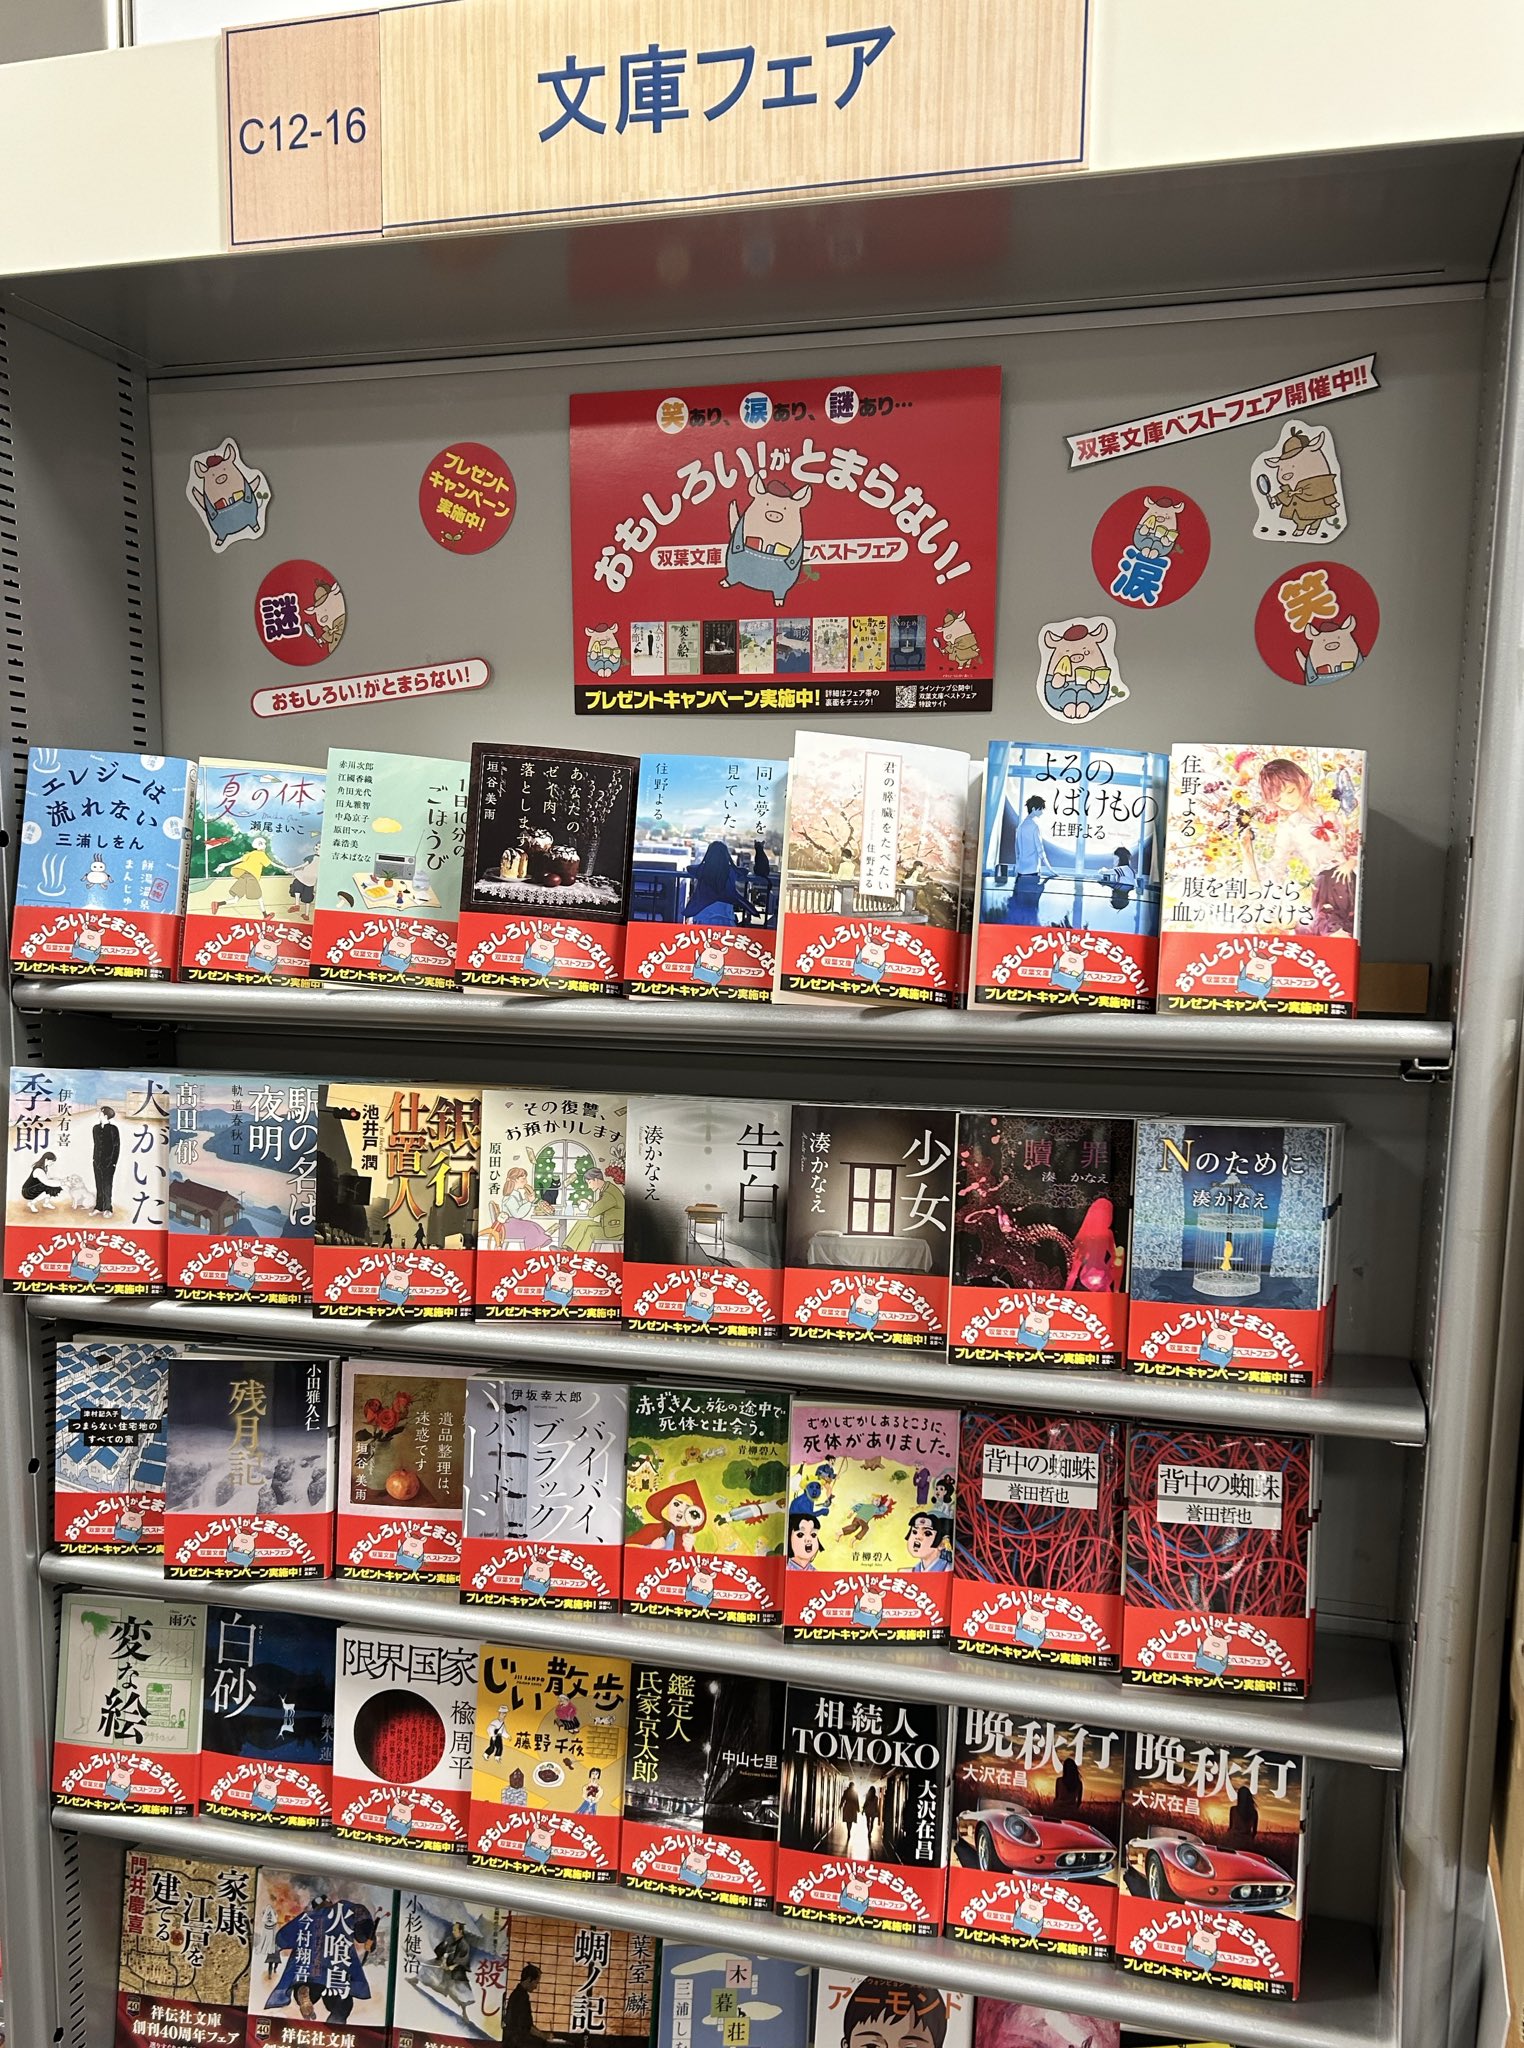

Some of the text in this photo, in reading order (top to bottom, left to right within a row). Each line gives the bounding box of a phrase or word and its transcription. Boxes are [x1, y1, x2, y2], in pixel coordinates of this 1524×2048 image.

[538, 25, 897, 141] 文庫フェア
[239, 106, 366, 156] C12-16
[1077, 366, 1367, 461] 双葉文庫ベストフェア開催中!!
[429, 471, 510, 517] キャンペーン
[444, 452, 509, 493] プレゼント
[435, 498, 486, 531] 実施中!
[594, 439, 971, 592] おもしろい!がとまらない!
[658, 548, 722, 567] 双葉文庫
[809, 541, 901, 560] ベストフェア
[1114, 548, 1167, 605] 涙
[262, 594, 301, 641] 謎
[1281, 571, 1338, 630] 笑
[272, 667, 470, 711] おもしろい!がとまらない!
[585, 689, 820, 709] プレゼントキャンペーン実施中!
[825, 689, 879, 698] 詳細はフェア帯の
[825, 698, 874, 707] 裏面をチェック!
[919, 692, 977, 700] 双葉文庫ベストフェア
[41, 762, 168, 804] エレジーは
[338, 773, 373, 784] 江國香織
[339, 760, 374, 771] 赤川次郎
[1034, 752, 1114, 784] よるの
[206, 773, 325, 822] 夏の体
[336, 800, 371, 810] 田丸雅智
[337, 787, 371, 797] 角田光代
[484, 760, 499, 821] 垣谷美雨
[517, 762, 535, 847] 落とします
[567, 767, 583, 833] あなたの
[653, 763, 669, 821] 住野よる
[723, 764, 740, 829] 見ていた
[755, 765, 773, 835] 同じ夢を
[1053, 788, 1158, 823] ばけもの
[1181, 755, 1202, 837] 住野よる
[45, 797, 158, 828] 流れない
[250, 820, 305, 835] 瀬尾まいこ
[333, 825, 366, 834] 原田マハ
[335, 813, 369, 823] 中島京子
[426, 785, 449, 871] ごほうび
[879, 760, 897, 891] 君の膵臓をたべたい
[1051, 821, 1107, 841] 住野よる
[56, 833, 145, 850] 三浦しをん
[332, 852, 371, 862] 吉本ばなな
[333, 839, 358, 849] 森浩美
[123, 859, 133, 913] まんじゅ
[865, 843, 876, 890] 住野よる
[1182, 877, 1301, 900] 腹を割ったら
[1170, 902, 1315, 926] 血が出るだけさ
[984, 987, 1135, 1009] プレゼントキャンペーン実施中!
[13, 1072, 54, 1154] 季節
[56, 1088, 73, 1147] 伊吹有喜
[248, 1086, 285, 1162] 夜明
[505, 1121, 624, 1142] お預かりします
[524, 1100, 606, 1121] その復讐、
[131, 1080, 169, 1225] 犬がいた
[286, 1087, 318, 1226] 駅の名は
[361, 1104, 379, 1170] 池井戸潤
[383, 1090, 429, 1221] 仕置人
[427, 1097, 482, 1208] 銀行
[1161, 1138, 1304, 1176] Nのために
[488, 1142, 502, 1195] 原田ひ香
[644, 1125, 664, 1201] 湊かなえ
[736, 1123, 784, 1223] 告白
[809, 1132, 831, 1213] 湊かなえ
[900, 1129, 951, 1232] 少女
[1192, 1190, 1269, 1210] 湊かなえ
[12, 1281, 149, 1295] プレゼントキャンペーン実施中!
[319, 1305, 458, 1318] プレゼントキャンペーン実施中!
[954, 1348, 1099, 1366] プレゼントキャンペーン実施中!
[305, 1364, 321, 1432] 小田雅久仁
[510, 1388, 582, 1403] 伊坂幸太郎
[636, 1391, 786, 1418] 赤ずきん、旅の途中で
[72, 1421, 158, 1432] つまらない住宅地の
[88, 1435, 134, 1444] すべての家
[228, 1380, 267, 1487] 残月記
[415, 1411, 430, 1472] 迷惑です
[658, 1417, 765, 1437] 死体と出会う。
[803, 1432, 951, 1458] 死体がありました。
[806, 1417, 946, 1436] むかしむかしあるところに、
[355, 1441, 369, 1501] 垣谷美雨
[437, 1413, 453, 1496] 遺品整理は、
[487, 1418, 515, 1503] バード
[738, 1445, 778, 1456] 青柳碧人
[984, 1447, 1096, 1481] 背中の蜘蛛
[530, 1418, 565, 1531] ブラック
[571, 1420, 606, 1543] バイバイ、
[1008, 1482, 1070, 1505] 誉田哲也
[1159, 1468, 1280, 1501] 背中の蜘蛛
[1186, 1503, 1253, 1525] 誉田哲也
[170, 1566, 302, 1578] プレゼントキャンペーン実施中!
[852, 1551, 892, 1563] 青柳碧人
[168, 1614, 198, 1627] 雨穴
[629, 1601, 760, 1623] プレゼントキャンペーン実施中!
[97, 1616, 154, 1745] 変な絵
[211, 1612, 257, 1719] 白砂
[343, 1638, 478, 1687] 限界国家
[484, 1656, 624, 1712] じい散歩
[631, 1671, 663, 1784] 氏家京太郎
[666, 1673, 696, 1742] 鑑定人
[814, 1697, 918, 1738] 相続人
[515, 1732, 585, 1757] 藤野千夜
[722, 1750, 778, 1770] 中山七里
[792, 1727, 940, 1770] TOMOKO
[964, 1707, 1119, 1773] 晩秋行
[962, 1765, 1028, 1788] 大沢在昌
[1134, 1731, 1296, 1801] 晩秋行
[915, 1780, 937, 1861] 大沢在昌
[1133, 1791, 1201, 1815] 大沢在昌
[127, 1857, 148, 1935] 門井慶喜
[151, 1872, 183, 1942] 建てる
[215, 1870, 250, 1947] 家康、
[181, 1892, 215, 1967] 江戸を
[403, 1895, 422, 1975] 小杉健治
[783, 1904, 916, 1933] プレゼントキャンペーン実施中!
[295, 1912, 313, 1982] 今村翔吾
[321, 1902, 354, 2000] 火喰鳥
[571, 1930, 611, 2033] 蜩ノ記
[625, 1934, 651, 2016] 葉室麟
[1124, 1957, 1268, 1993] プレゼントキャンペーン実施中!
[150, 2006, 222, 2027] 祥伝社文庫
[828, 1985, 964, 2020] アーモンド
[132, 2020, 240, 2044] 創刊40周年フェア
[281, 2027, 356, 2048] 祥伝社文庫
